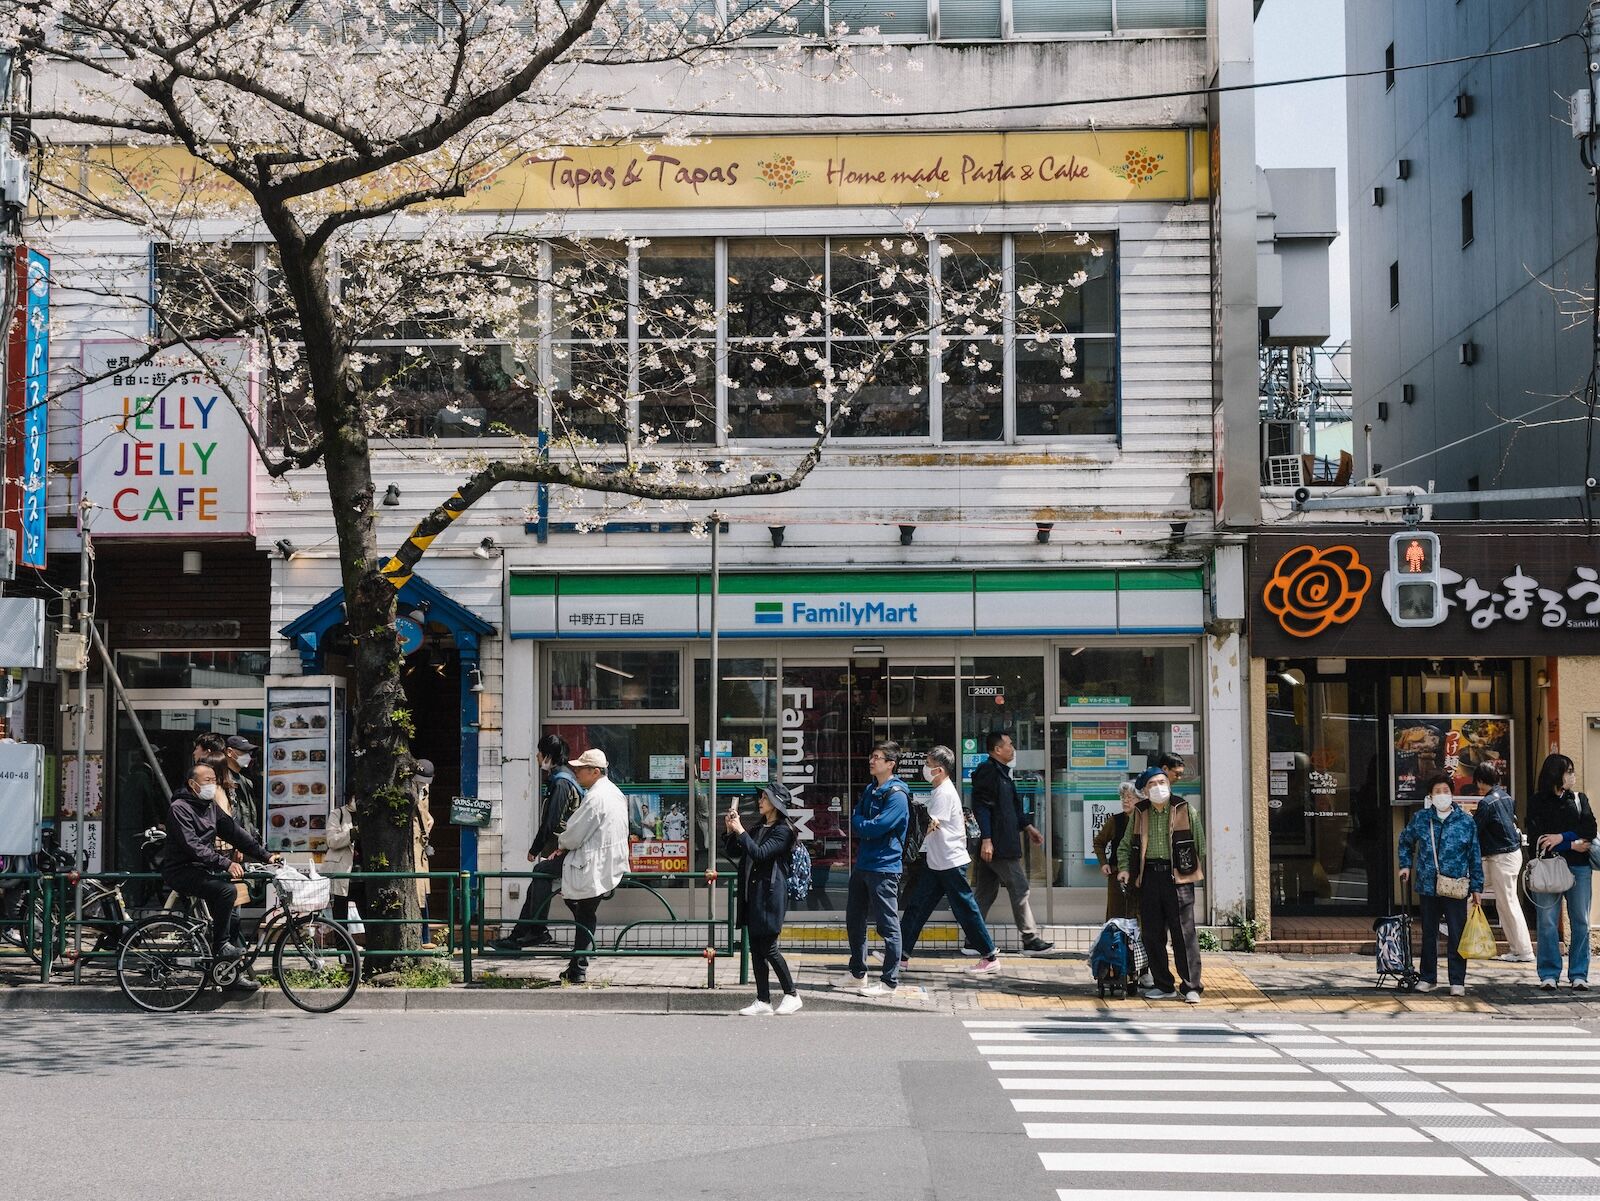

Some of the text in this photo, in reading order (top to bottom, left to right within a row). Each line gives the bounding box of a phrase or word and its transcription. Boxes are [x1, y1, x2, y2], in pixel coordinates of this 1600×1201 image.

[522, 154, 739, 206] Tapas & Tapas
[826, 154, 1090, 185] Home made Pasta & Cake
[115, 396, 218, 431] JELLY
[113, 442, 218, 476] JELLY
[112, 487, 218, 522] CAFE
[568, 612, 645, 626] 中野五丁目店
[792, 601, 918, 626] FamilyMart
[1567, 619, 1599, 628] Sanuki
[87, 823, 97, 859] 株式会社
[660, 859, 688, 870] 100円
